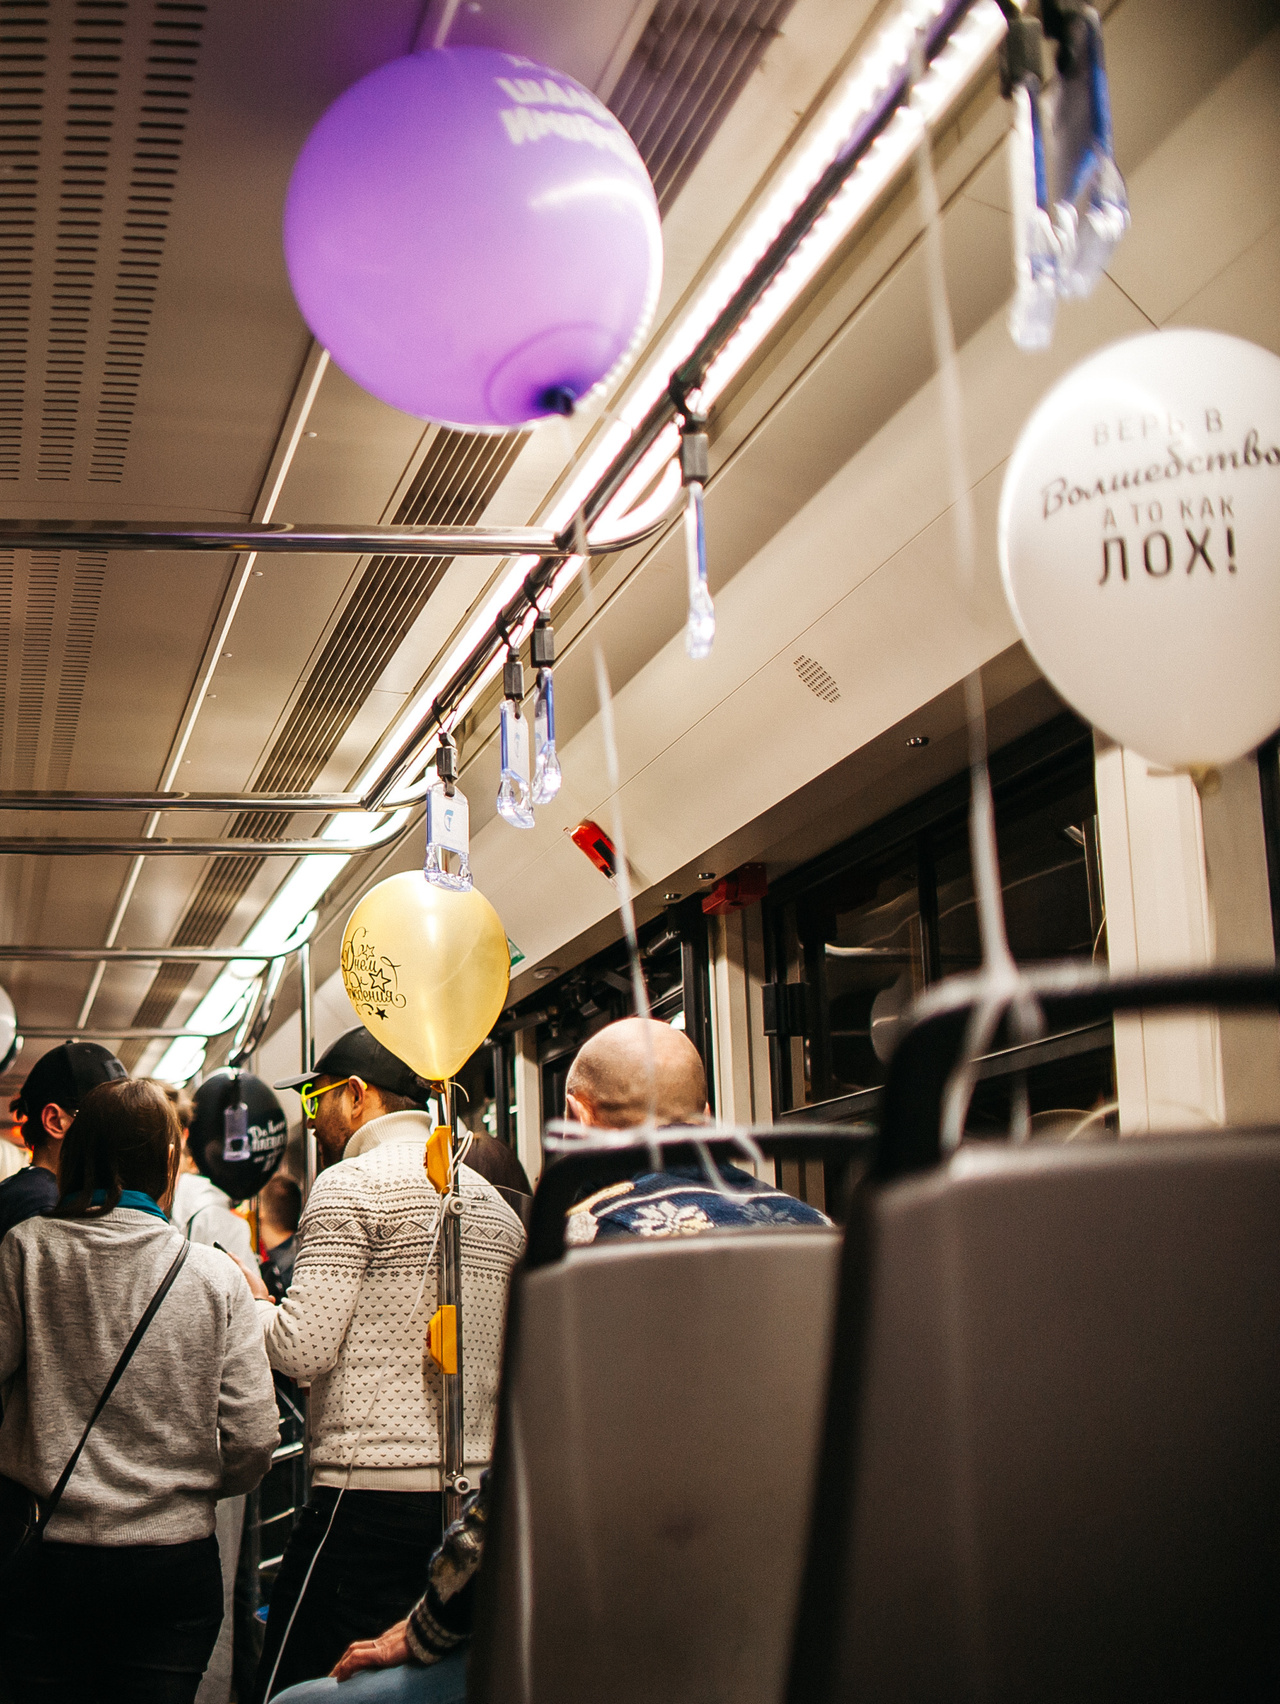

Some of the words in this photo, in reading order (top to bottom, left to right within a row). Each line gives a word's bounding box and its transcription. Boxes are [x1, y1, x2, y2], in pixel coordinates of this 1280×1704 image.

[1093, 412, 1186, 446] ВЕРЬ
[1205, 407, 1223, 433] В
[1103, 507, 1117, 529] А
[1131, 501, 1163, 525] ТО
[1179, 496, 1235, 520] КАК
[1099, 526, 1237, 586] ЛОХ!
